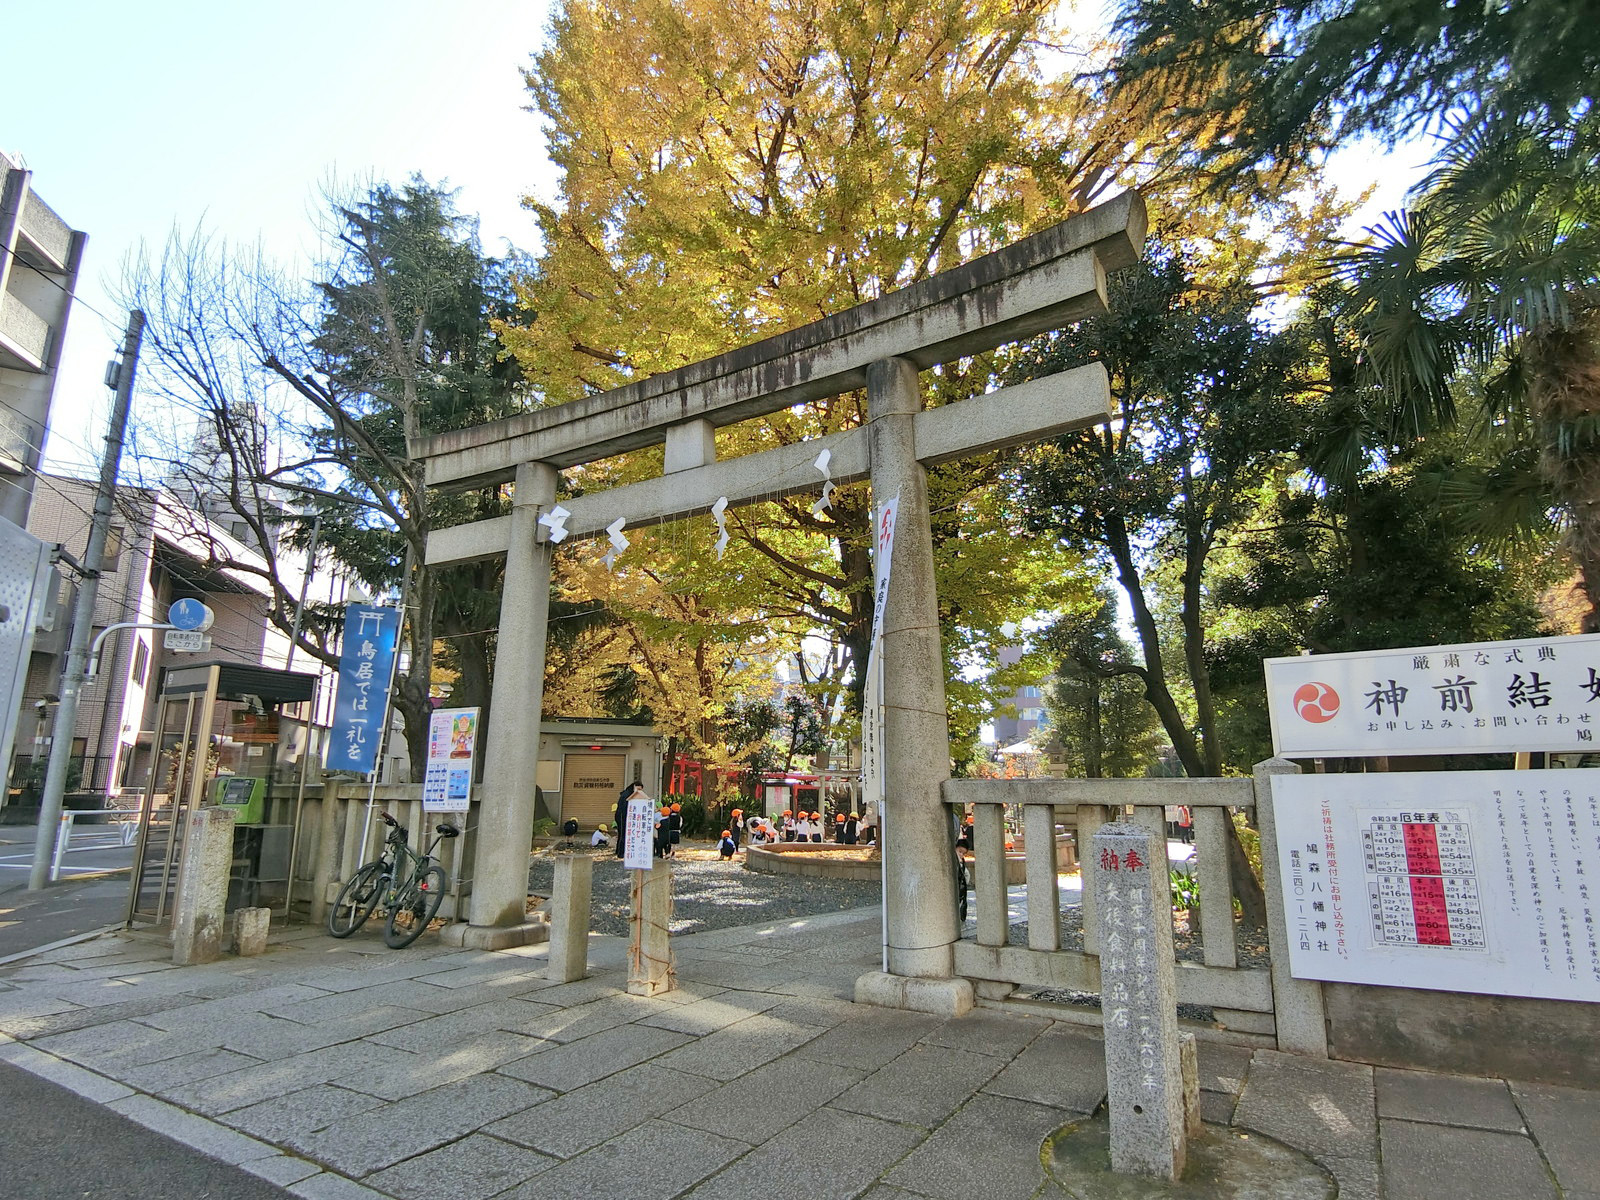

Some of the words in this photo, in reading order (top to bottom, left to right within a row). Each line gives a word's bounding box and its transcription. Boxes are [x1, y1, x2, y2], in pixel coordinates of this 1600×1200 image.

[1413, 647, 1556, 670] 厳粛な式典
[346, 640, 378, 760] 鳥居では一礼を
[1368, 713, 1592, 732] お申し込み、お問い合わせ
[1400, 812, 1439, 822] 厄年表
[1307, 844, 1329, 951] 鳩森八幡神社
